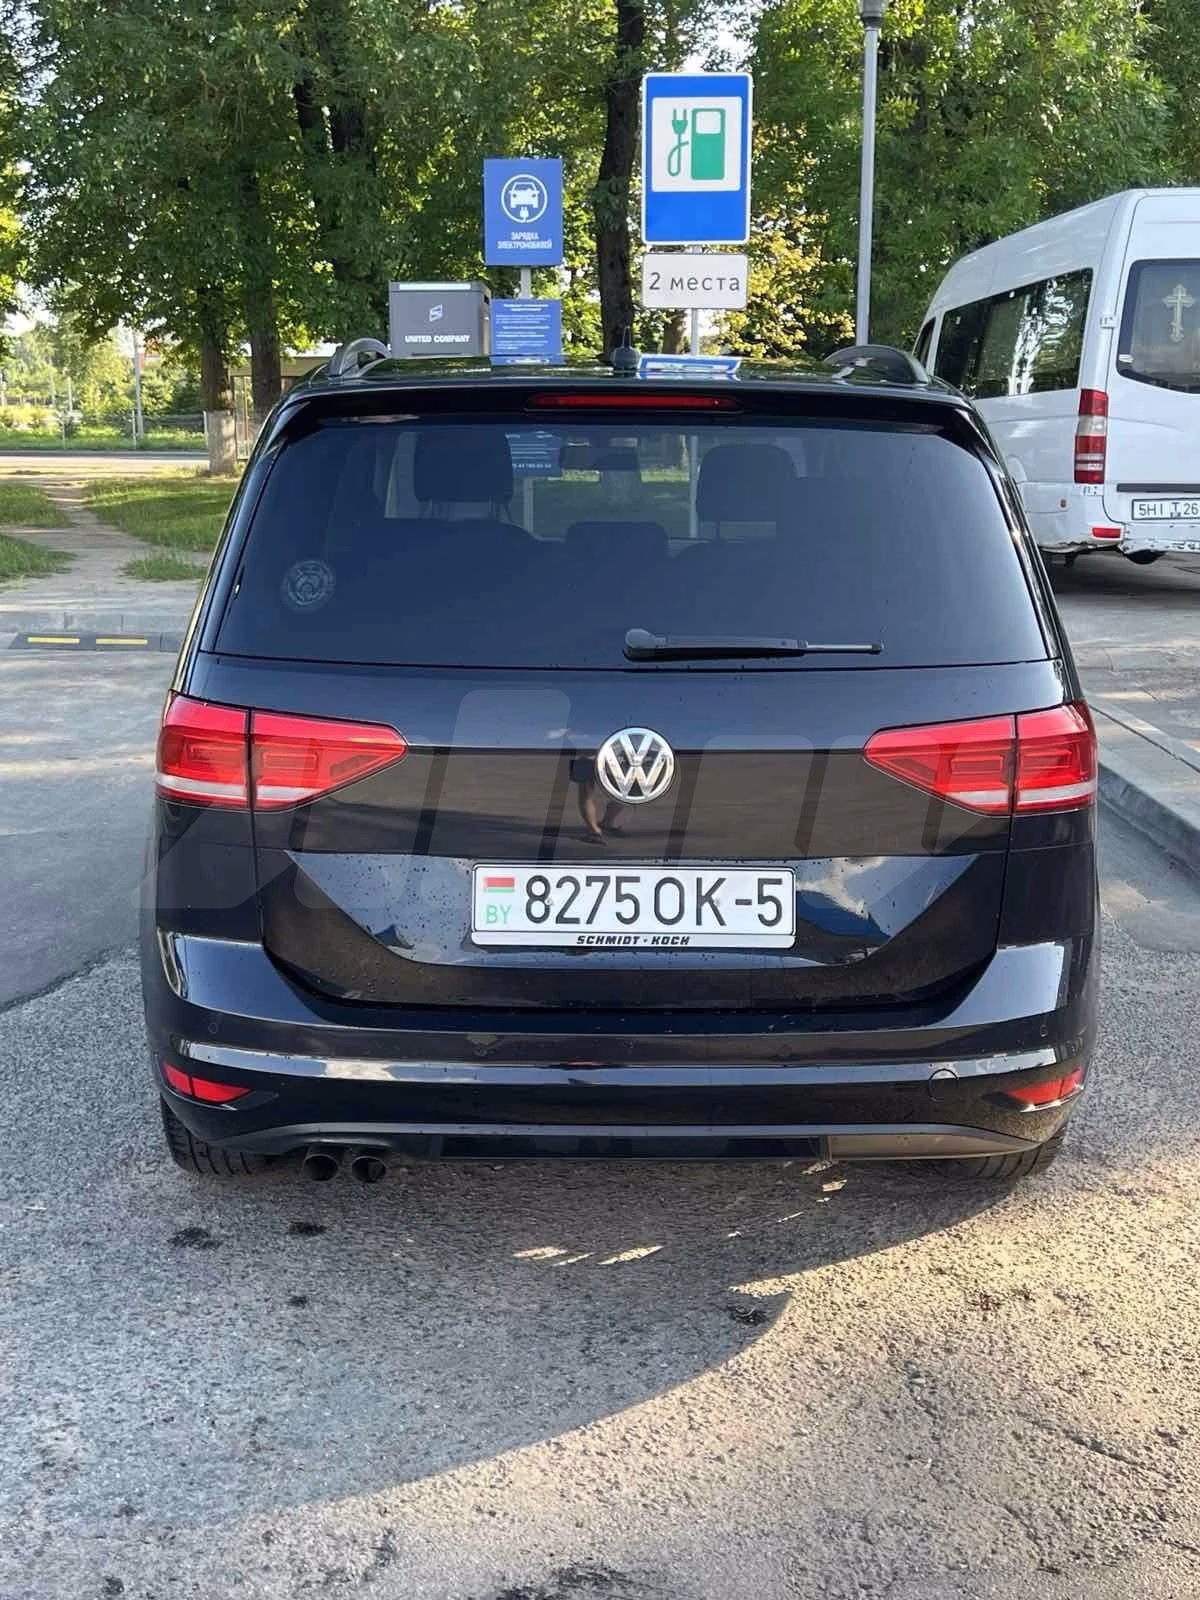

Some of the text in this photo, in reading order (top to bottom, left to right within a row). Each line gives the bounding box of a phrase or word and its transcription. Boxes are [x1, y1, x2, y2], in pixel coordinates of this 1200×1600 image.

[649, 271, 740, 291] 2 места
[404, 335, 470, 343] UNITED COMPANY
[485, 904, 512, 925] BY
[576, 935, 641, 945] SCHMIDT
